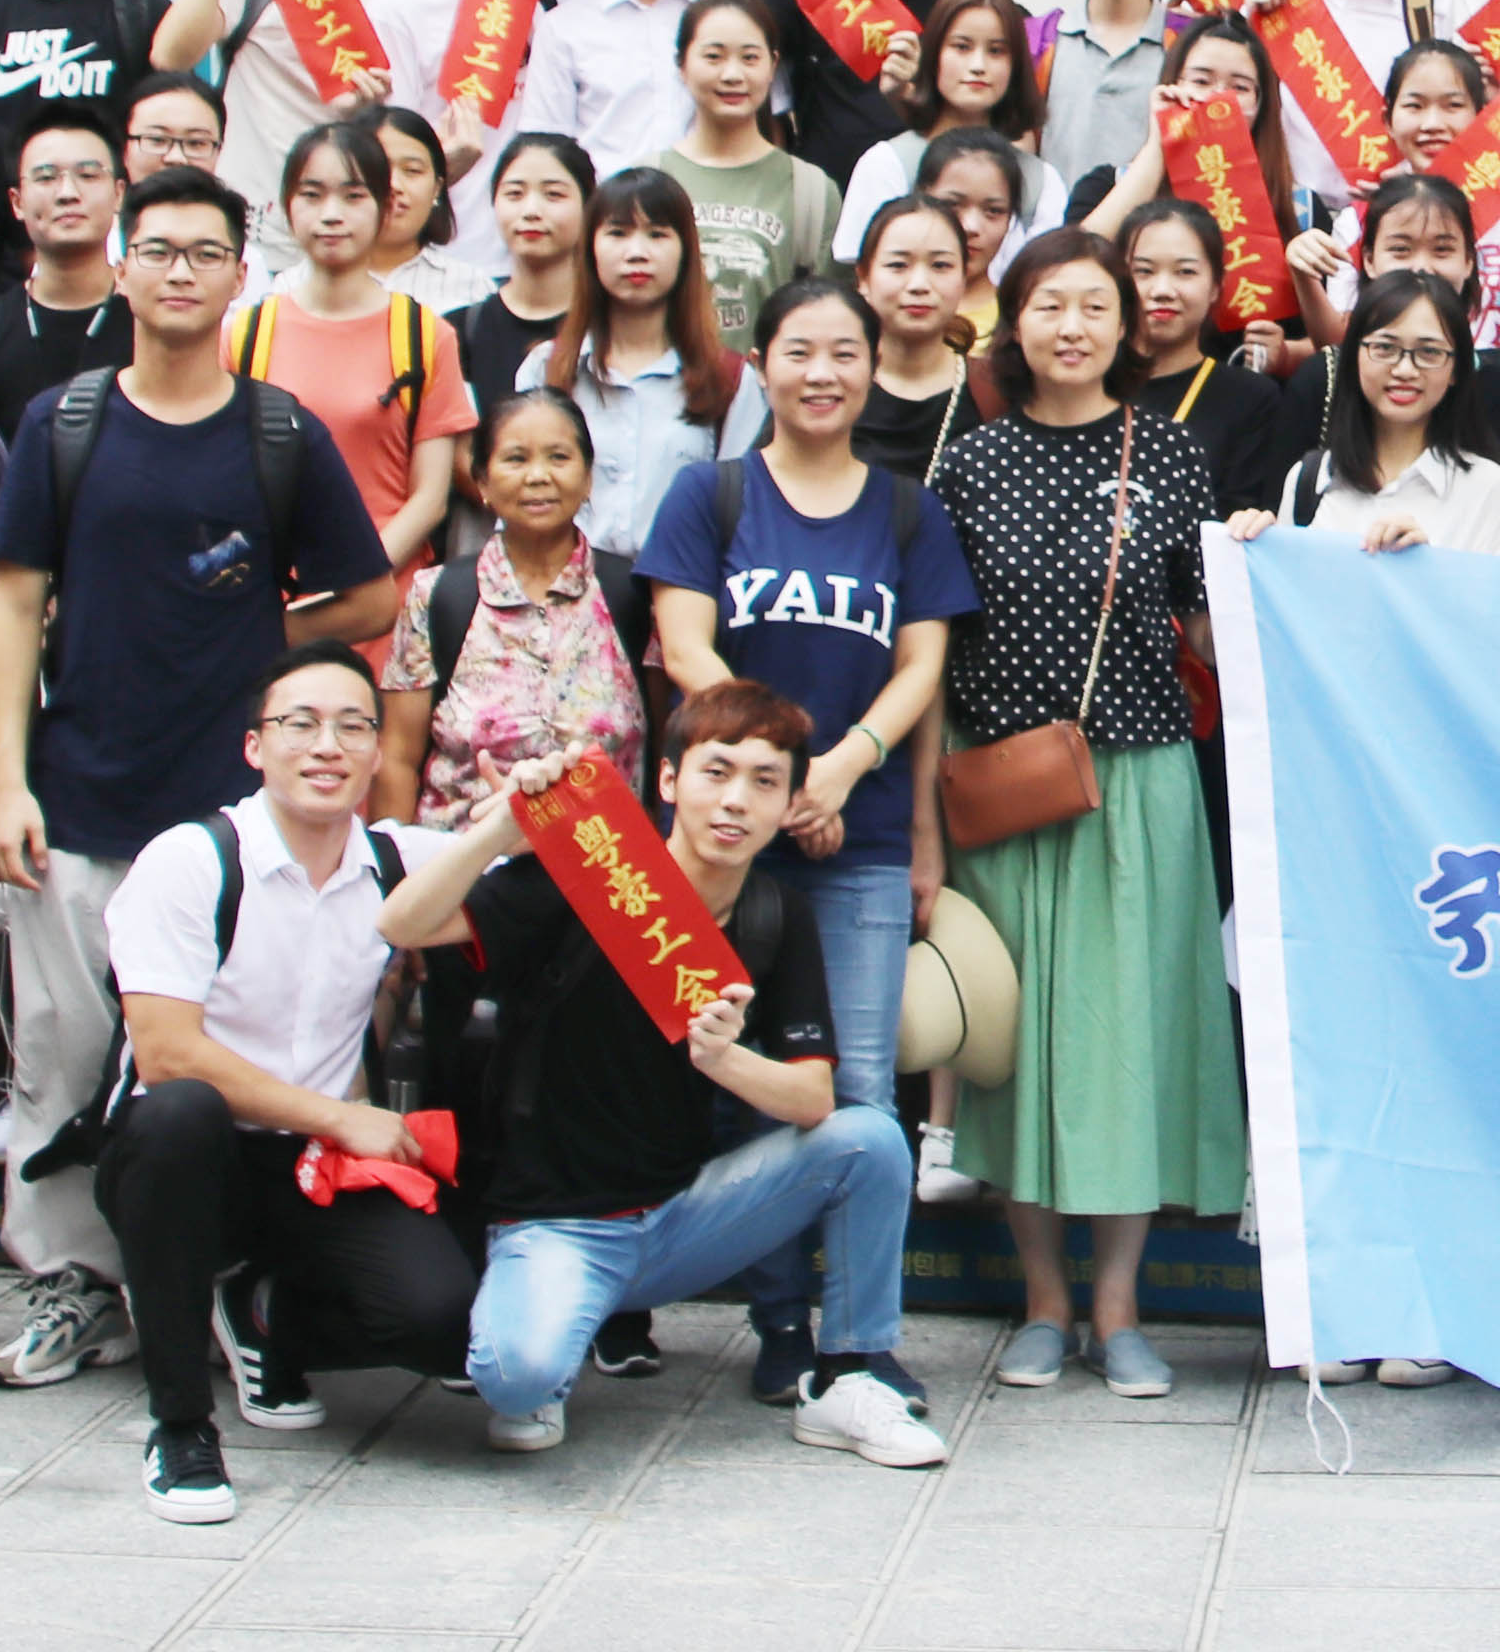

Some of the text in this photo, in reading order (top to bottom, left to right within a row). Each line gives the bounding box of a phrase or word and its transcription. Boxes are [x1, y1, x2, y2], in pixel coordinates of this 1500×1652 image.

[1292, 27, 1391, 172] 粤豪工会
[1191, 144, 1273, 318] 粤豪工会
[572, 812, 722, 1016] 粤豪工会
